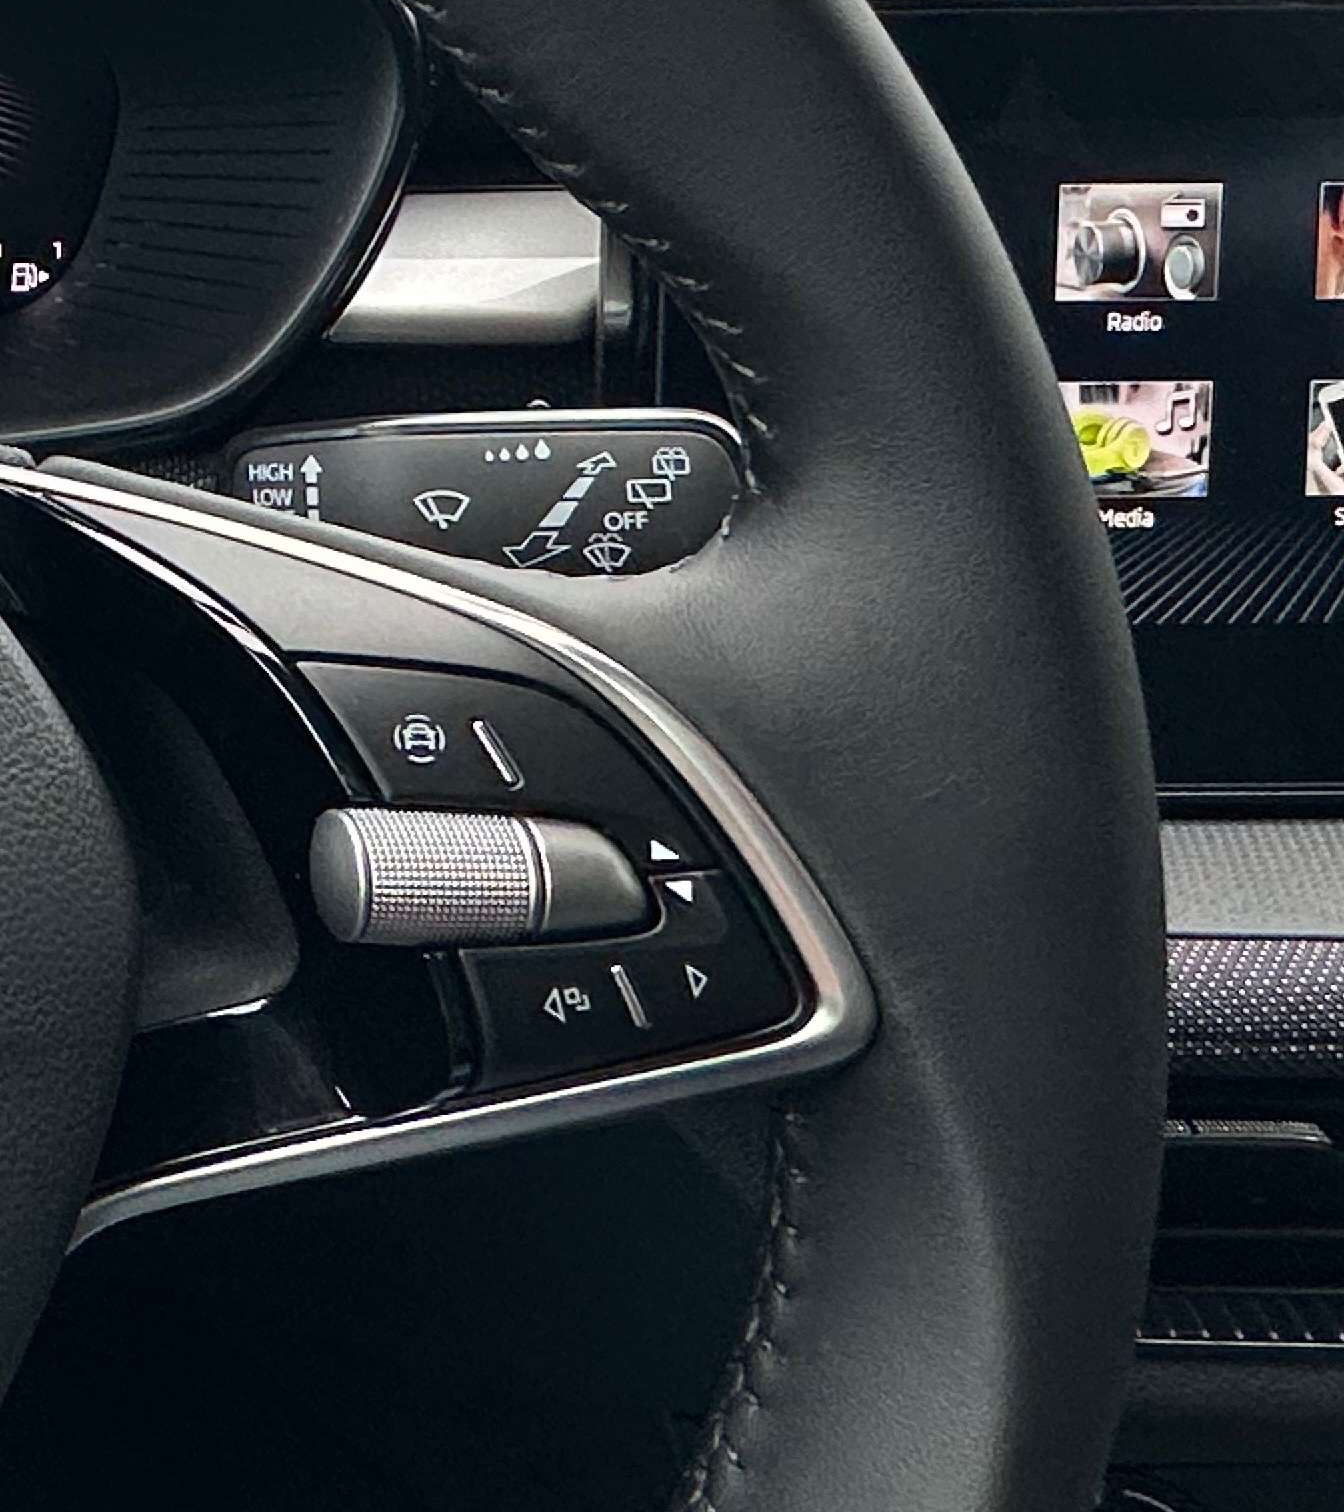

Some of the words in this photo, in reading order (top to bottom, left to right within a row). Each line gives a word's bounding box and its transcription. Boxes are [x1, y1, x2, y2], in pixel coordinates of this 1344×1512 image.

[52, 240, 62, 260] 1
[1106, 310, 1163, 332] Radio
[248, 462, 294, 483] HIGH
[252, 488, 294, 507] LOW
[602, 510, 650, 532] OFF
[1098, 506, 1154, 528] Media
